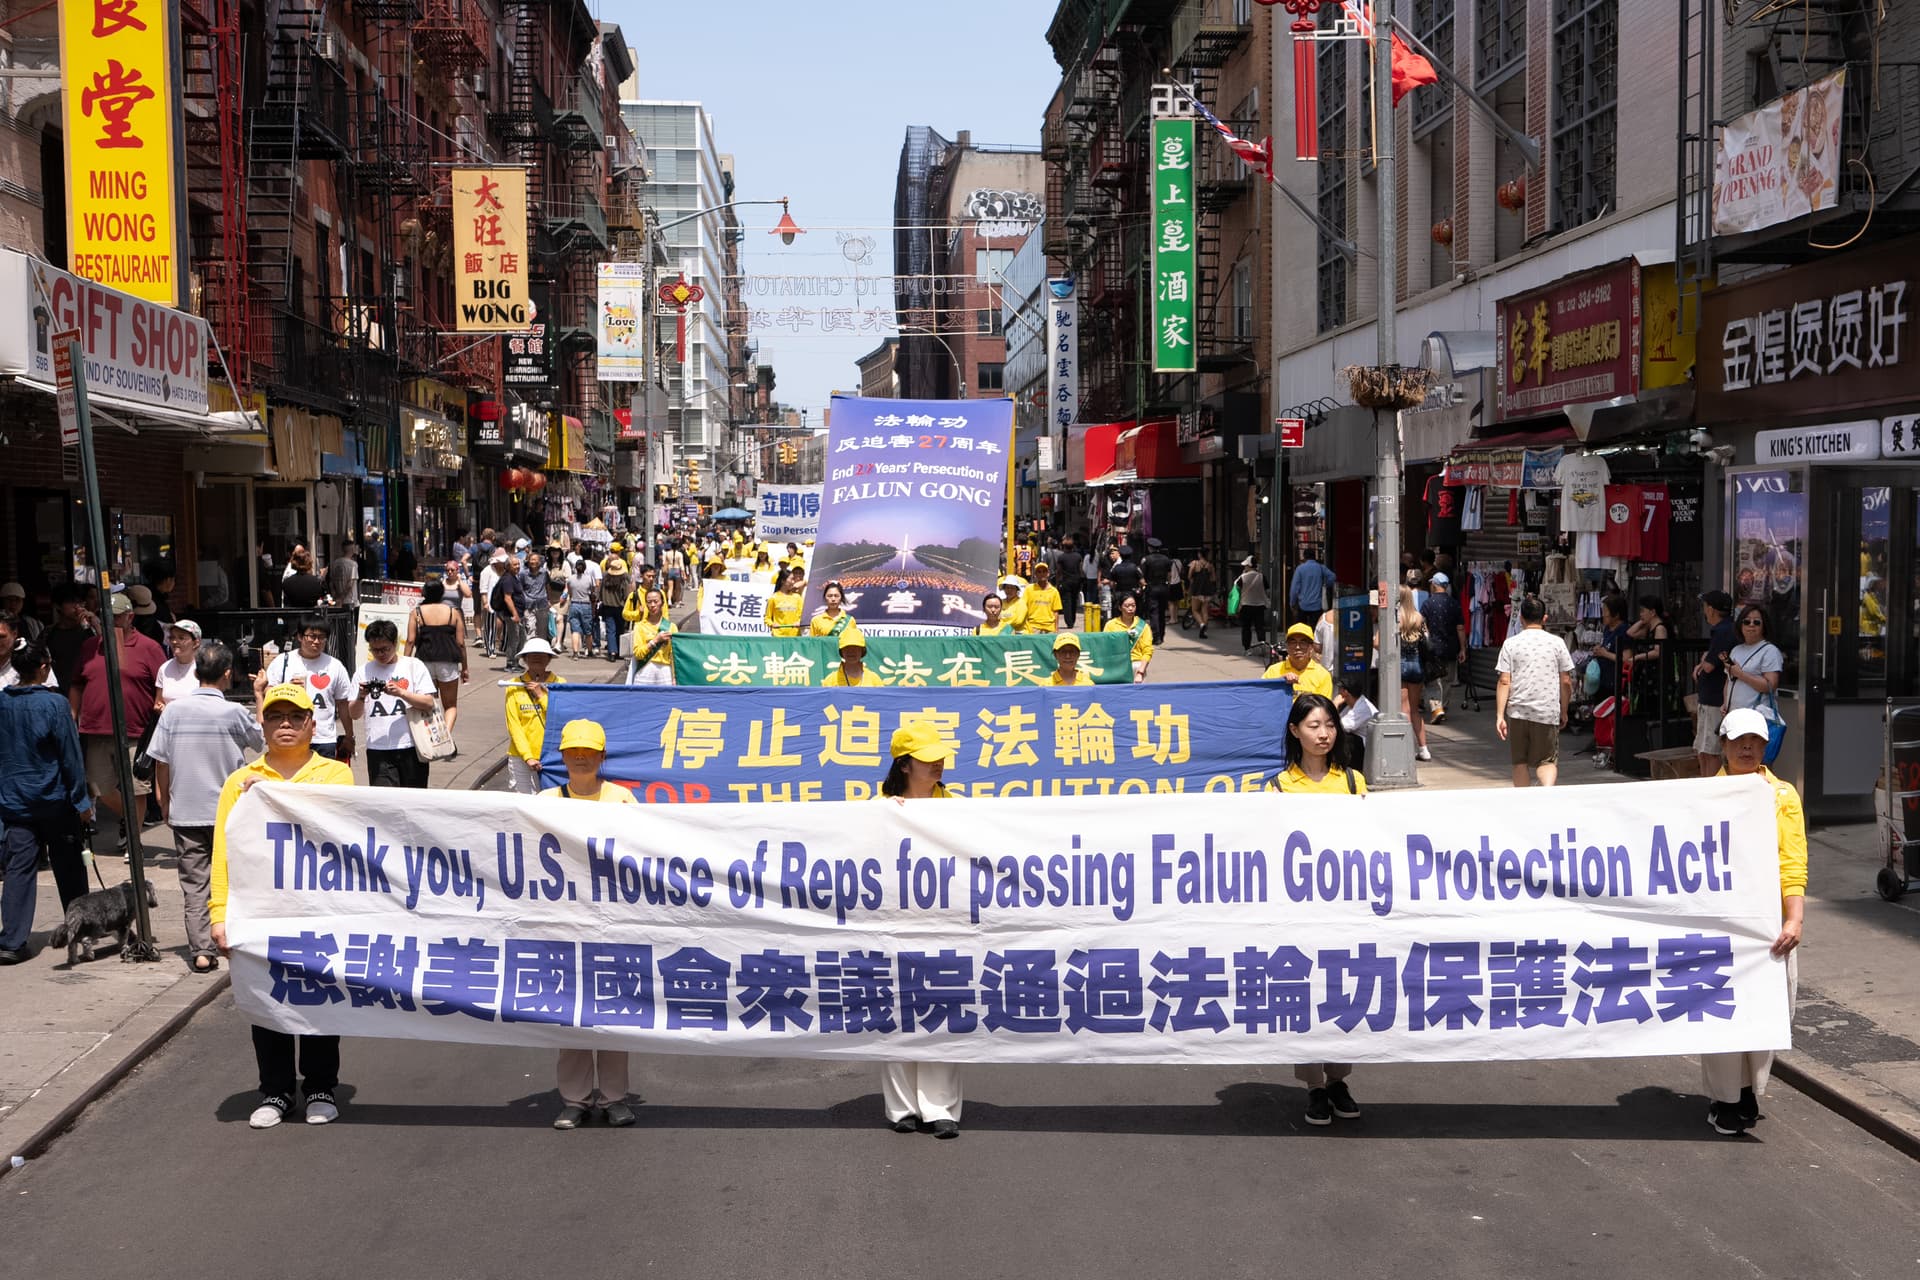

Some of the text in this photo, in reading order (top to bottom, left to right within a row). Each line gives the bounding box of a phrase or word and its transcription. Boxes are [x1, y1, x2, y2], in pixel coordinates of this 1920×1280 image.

[89, 170, 147, 200] MING
[474, 175, 506, 247] 大旺
[84, 213, 156, 241] WONG
[75, 254, 170, 283] RESTAURANT
[464, 252, 518, 273] 飯店
[473, 279, 510, 299] BIG
[461, 303, 525, 323] WONG
[608, 317, 635, 326] Love
[52, 277, 199, 378] GIFT SHOP
[1723, 280, 1907, 392] 金煌煲煲好
[103, 366, 114, 385] OF
[116, 370, 161, 397] SOUVENIRS
[479, 429, 499, 439] 456
[874, 414, 968, 428] 法輪功
[835, 434, 1001, 454] 反迫害27周年
[1770, 432, 1850, 457] KING'S KITCHEN
[832, 464, 854, 480] End
[913, 462, 984, 481] Persecution
[985, 471, 999, 484] of
[831, 481, 991, 507] FALUN GONG
[762, 523, 781, 537] Stop
[1643, 504, 1656, 532] 7
[714, 590, 764, 618] 共產
[1349, 610, 1360, 629] P
[612, 780, 711, 803] TOP
[728, 779, 823, 803] THE
[845, 777, 1184, 803] PSECUTION
[266, 821, 1734, 925] Thank you, U.S. House of Reps for passing Falun Gong Protection Act!
